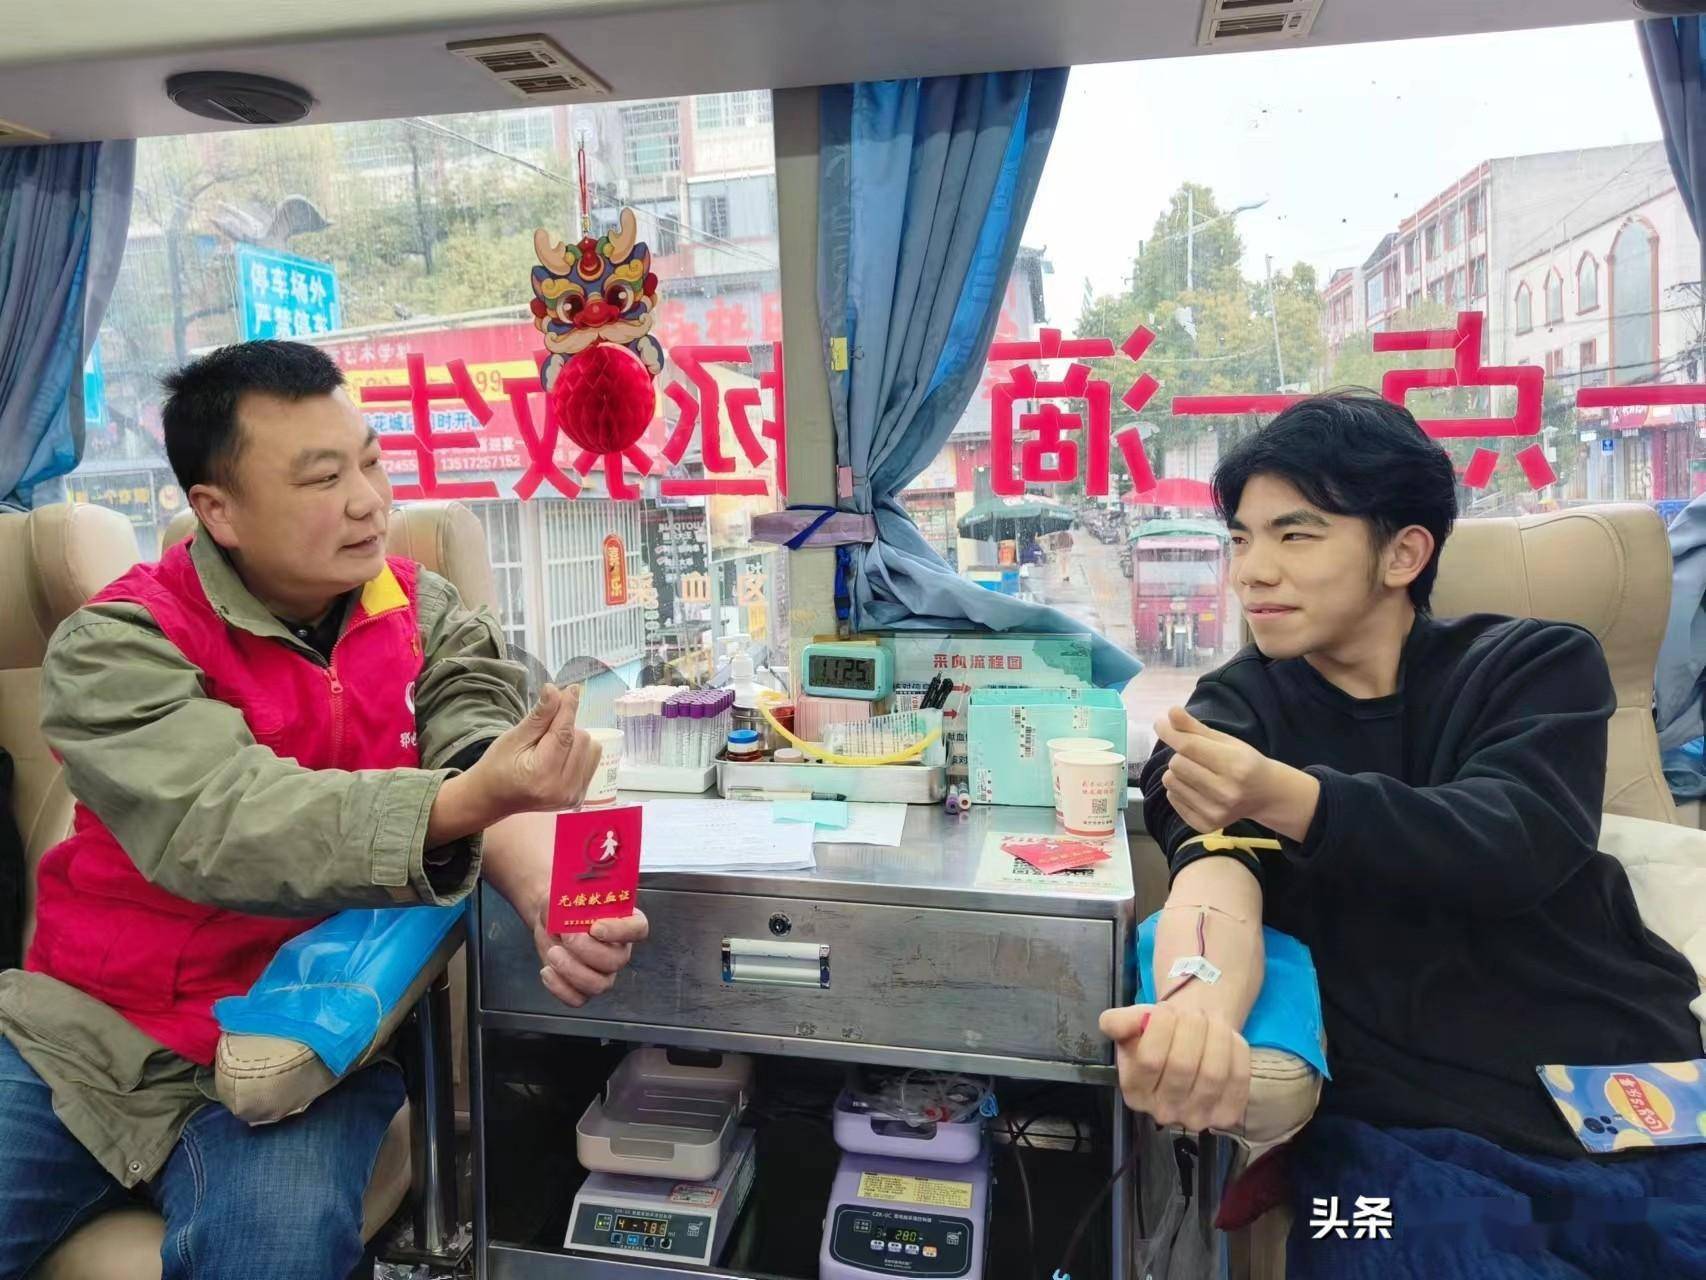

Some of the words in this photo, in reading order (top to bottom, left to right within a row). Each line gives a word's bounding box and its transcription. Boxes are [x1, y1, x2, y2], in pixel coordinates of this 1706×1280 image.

[251, 262, 328, 307] 停车场外
[933, 654, 1023, 670] 采血流程图
[557, 890, 631, 908] 无偿献血证
[895, 1229, 917, 1243] 280
